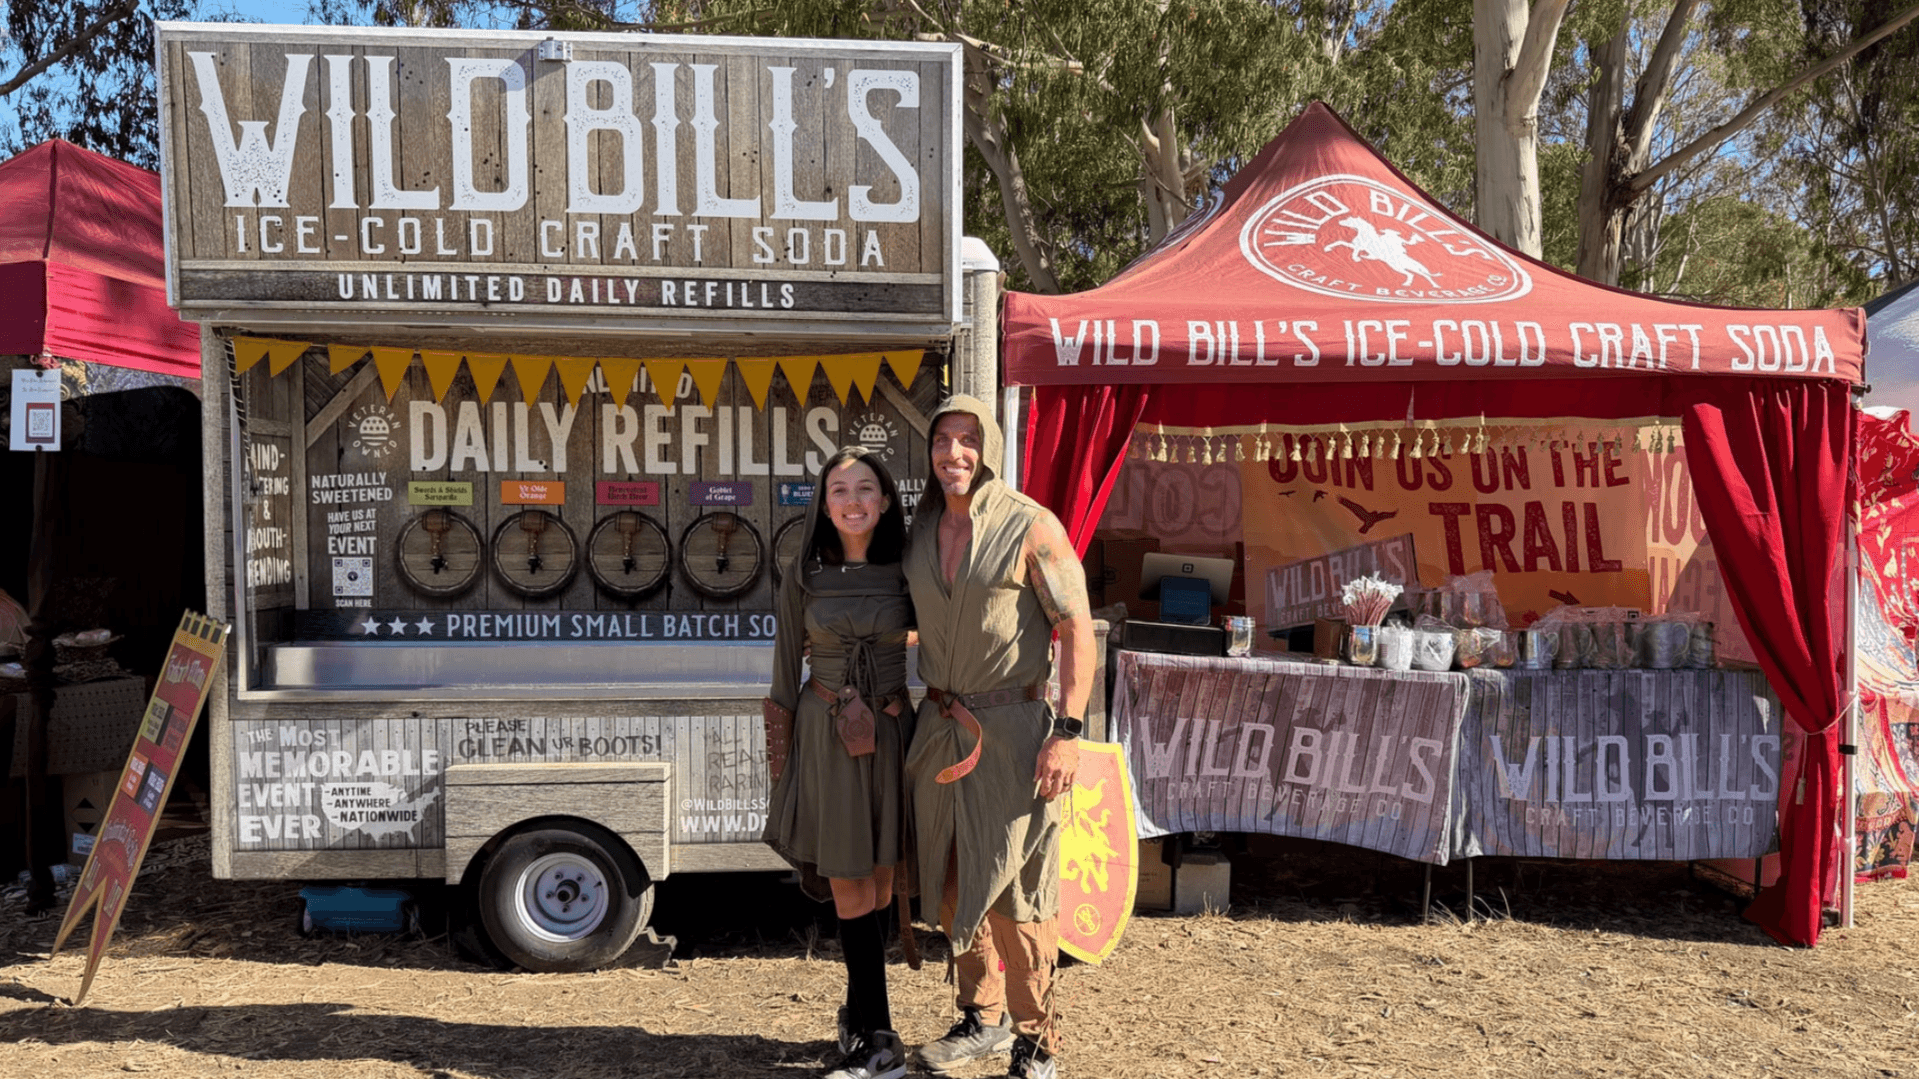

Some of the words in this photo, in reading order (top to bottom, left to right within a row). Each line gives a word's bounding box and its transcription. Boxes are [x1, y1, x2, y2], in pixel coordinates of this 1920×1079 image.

[188, 51, 532, 211] WILD
[565, 60, 920, 222] BILL'S
[1264, 189, 1350, 248] WILD
[1370, 188, 1495, 261] BILL'S
[236, 215, 494, 257] ICE-COLD
[541, 221, 704, 262] CRAFT
[753, 226, 885, 267] SODA
[337, 272, 525, 302] UNLIMITED
[547, 275, 640, 306] DAILY
[662, 280, 796, 310] REFILLS
[1287, 263, 1363, 291] CRAFT
[1376, 279, 1489, 299] BEVERAGE
[1049, 317, 1161, 367] WILD
[1187, 319, 1319, 367] BILL'S
[1344, 319, 1546, 368] ICE-COLD
[1573, 322, 1704, 371] CRAFT
[1731, 324, 1836, 375] SODA
[348, 404, 401, 429] VETERAN
[849, 412, 899, 437] VETERAN
[352, 440, 397, 458] OWNED
[409, 400, 577, 473] DAILY
[601, 402, 839, 476] REFILLS
[1397, 441, 1453, 491] US
[1471, 443, 1531, 494] ON
[1541, 440, 1629, 488] THE
[311, 472, 387, 489] NATURALLY
[709, 486, 733, 494] Goblet
[312, 487, 393, 505] SWEETENED
[519, 493, 547, 501] Orange
[714, 494, 736, 502] Grape
[263, 499, 272, 520] &
[327, 510, 350, 523] HAVE
[352, 509, 365, 520] US
[366, 508, 377, 519] AT
[328, 522, 352, 535] YOUR
[354, 520, 377, 532] NEXT
[1428, 500, 1623, 577] TRAIL
[327, 536, 378, 555] EVENT
[1270, 560, 1326, 609] WILD
[335, 598, 354, 608] SCAN
[355, 598, 372, 608] HERE
[446, 615, 561, 638] PREMIUM
[570, 615, 654, 638] SMALL
[663, 615, 740, 638] BATCH
[248, 728, 273, 744] THE
[465, 719, 528, 735] PLEASE
[458, 737, 546, 759] CLEAN
[552, 736, 575, 750] UR
[579, 735, 662, 757] BOOTS!
[239, 750, 439, 779] MEMORABLE
[1139, 716, 1275, 780] WILD
[1282, 726, 1444, 804] BILL'S
[1489, 735, 1631, 801] WILD
[1644, 733, 1781, 801] BILL'S
[238, 782, 315, 808] EVENT
[1166, 781, 1234, 800] CRAFT
[1248, 781, 1360, 814] BEVERAGE
[1376, 799, 1402, 821] CO
[239, 814, 322, 843] EVER
[1525, 806, 1598, 827] CRAFT
[1728, 806, 1755, 825] CO
